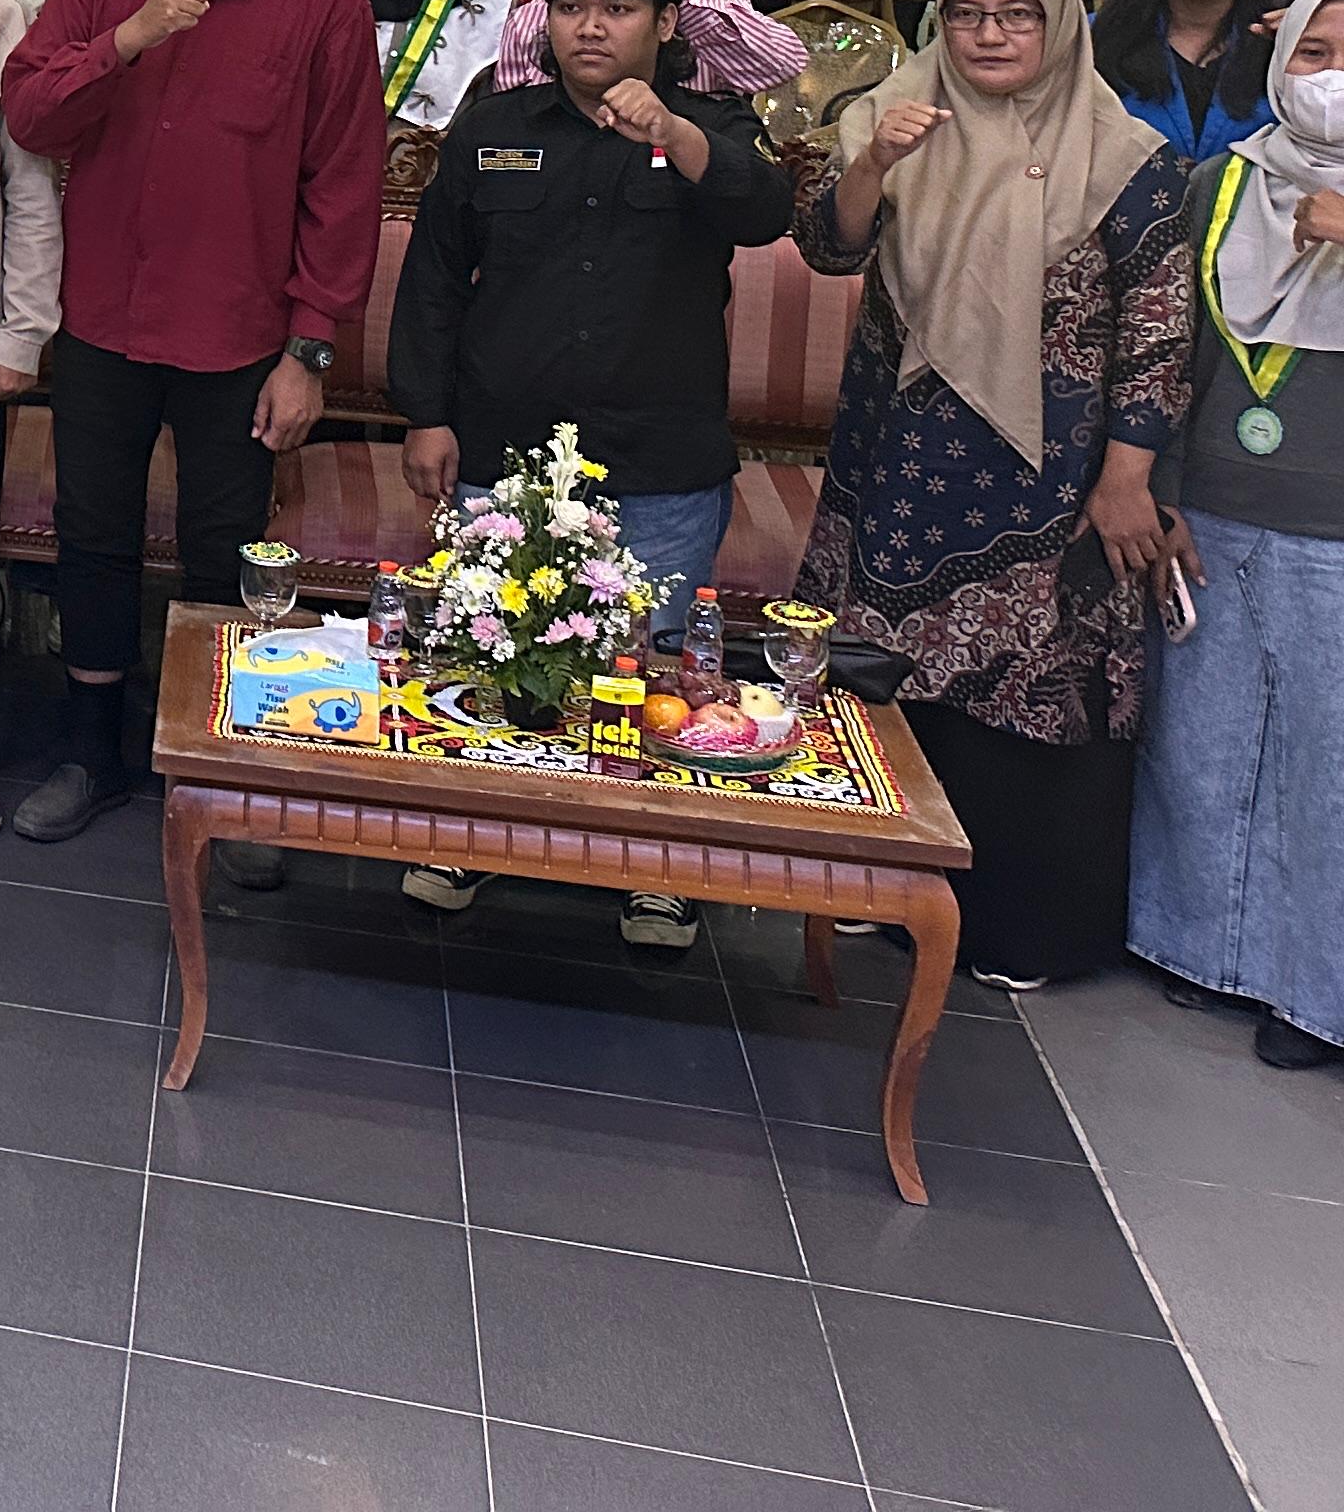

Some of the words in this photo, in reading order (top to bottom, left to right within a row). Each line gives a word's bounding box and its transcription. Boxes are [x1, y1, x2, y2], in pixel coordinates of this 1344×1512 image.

[265, 692, 286, 703] Tisu
[258, 702, 289, 714] Wajah
[592, 717, 641, 746] teh
[591, 740, 640, 760] kotak
